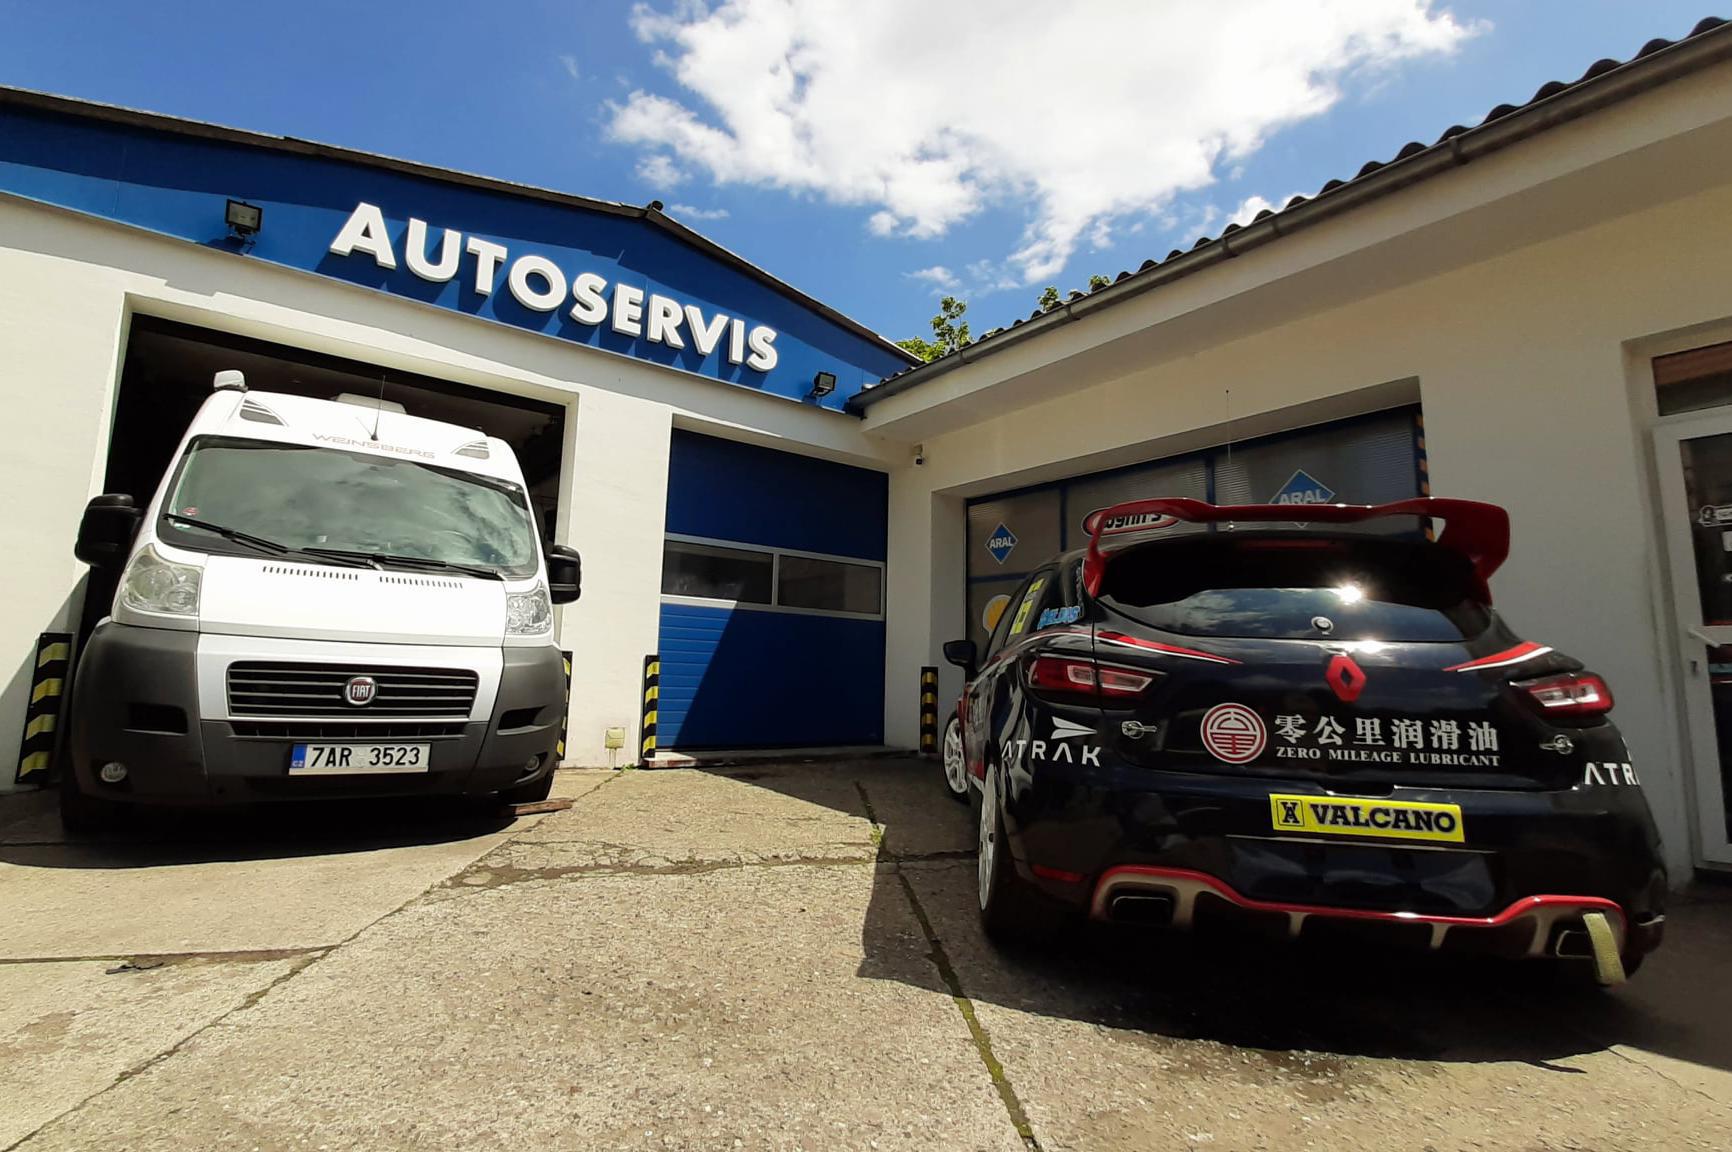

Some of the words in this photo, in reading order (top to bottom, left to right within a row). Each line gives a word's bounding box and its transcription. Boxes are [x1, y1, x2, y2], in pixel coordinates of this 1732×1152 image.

[330, 202, 778, 373] AUTOSERVIS
[312, 433, 436, 459] WEINSBERG
[1279, 489, 1325, 504] ARAL
[989, 537, 1014, 549] ARAL
[352, 685, 370, 698] FIAT
[1274, 713, 1499, 752] 零公里润滑油
[311, 747, 352, 767] 7AR
[369, 747, 420, 766] 3523
[1001, 739, 1102, 767] ATRAK
[1275, 746, 1321, 760] ZERO
[1328, 749, 1402, 763] MILEAGE
[1409, 752, 1500, 767] LUBRICANT
[1584, 762, 1640, 785] ATR
[1310, 803, 1456, 832] VALCANO
